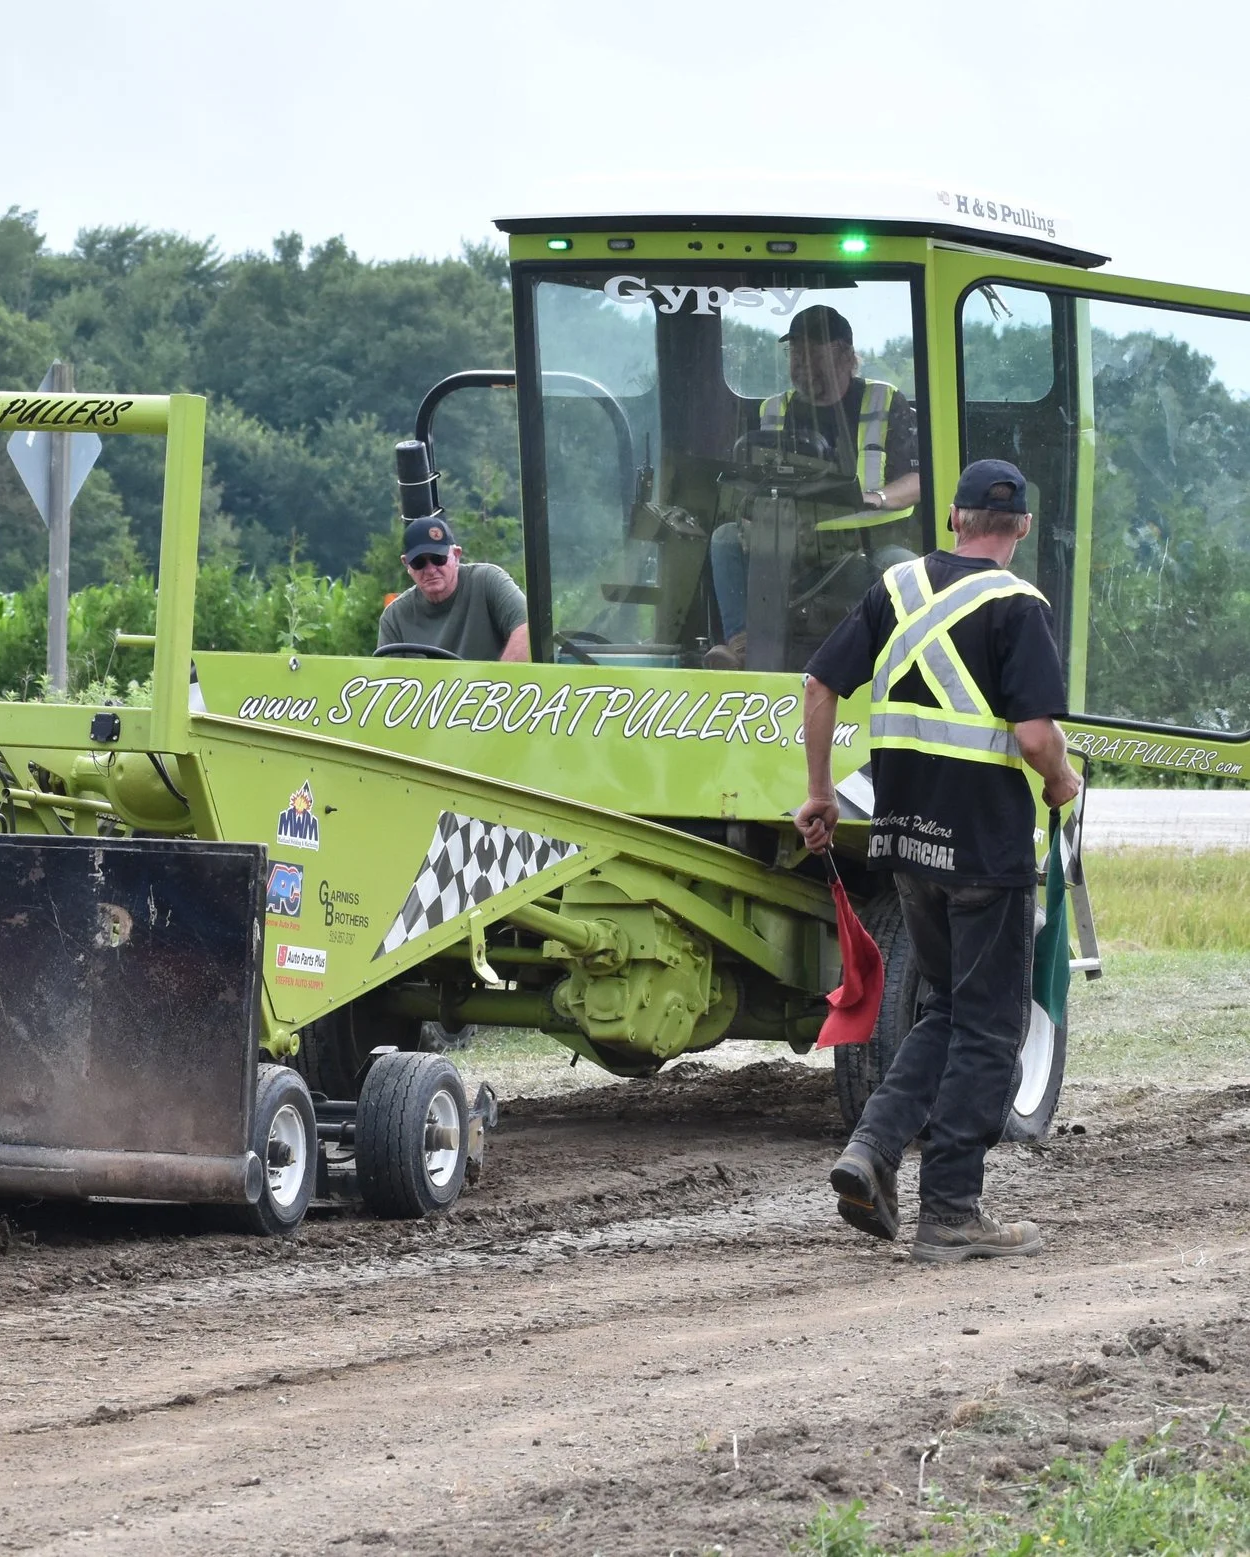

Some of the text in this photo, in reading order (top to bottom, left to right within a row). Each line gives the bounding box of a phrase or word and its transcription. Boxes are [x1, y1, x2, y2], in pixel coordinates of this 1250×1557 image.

[955, 194, 1056, 238] H & S Pulling
[603, 275, 809, 316] Gypsy
[239, 676, 859, 748] www.STONEBOATPULLERS.cm
[277, 808, 318, 842] MWM
[912, 815, 952, 838] Pullers
[319, 880, 360, 905] GARNISS
[324, 902, 369, 928] BROTHERS
[287, 951, 301, 965] Auto
[301, 953, 315, 967] Parts
[314, 955, 326, 969] Plus
